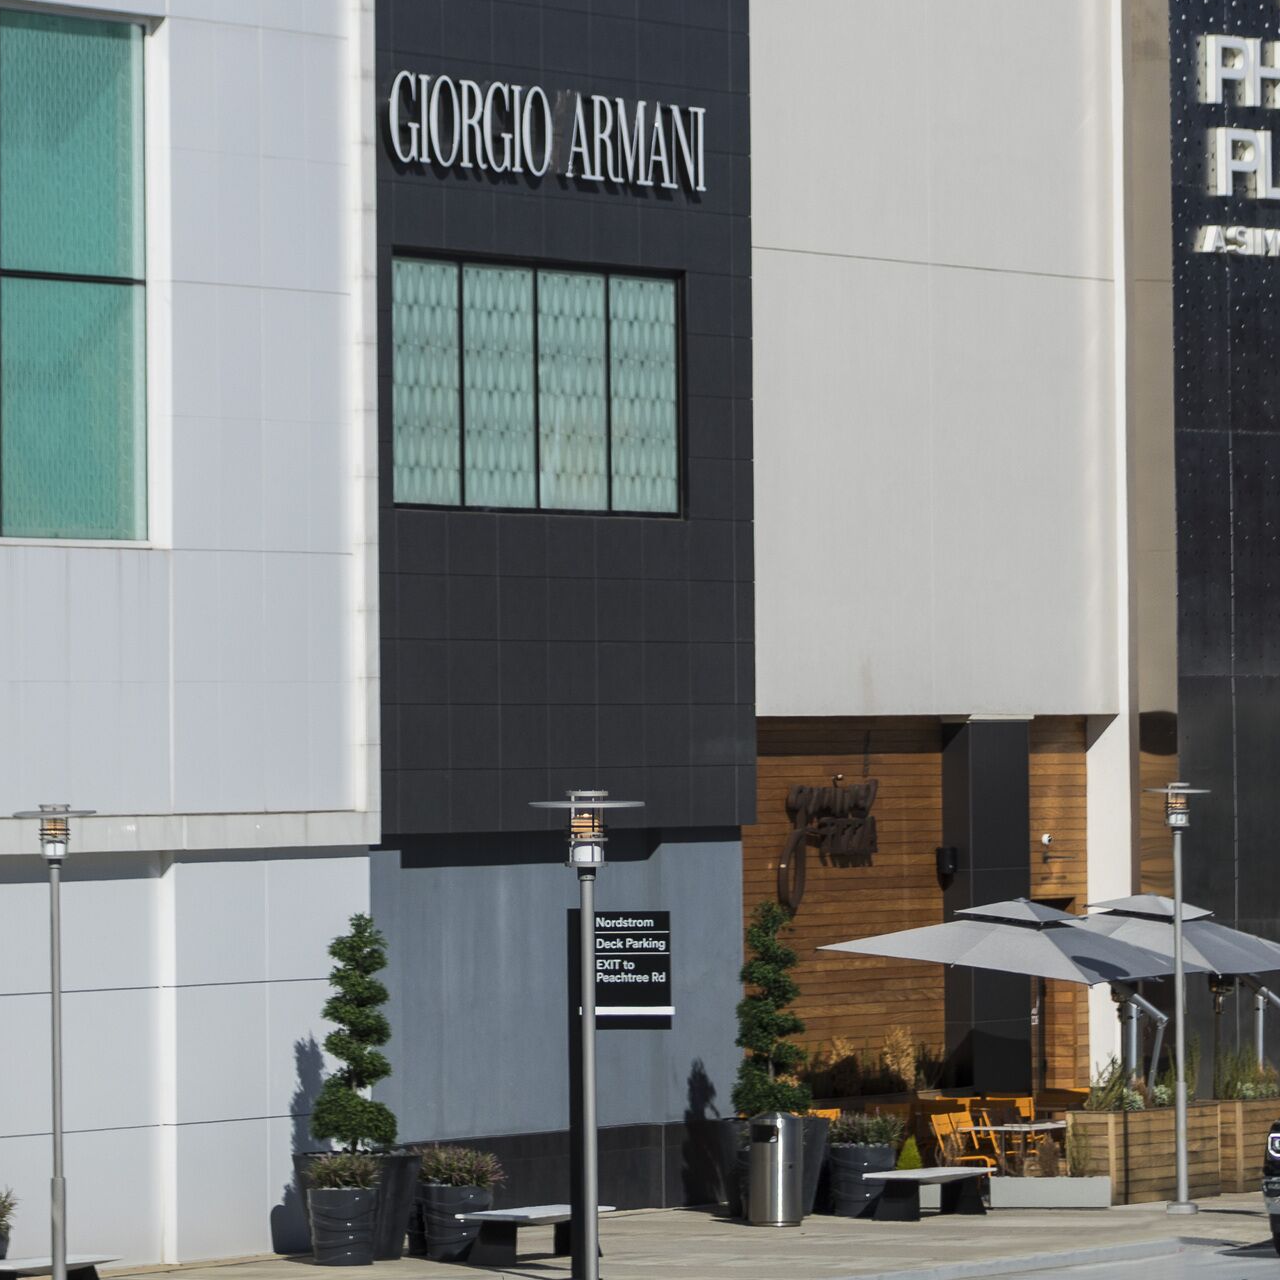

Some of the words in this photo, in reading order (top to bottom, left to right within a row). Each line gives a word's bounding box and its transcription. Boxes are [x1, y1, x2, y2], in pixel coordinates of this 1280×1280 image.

[389, 70, 553, 177] GIORGIO
[566, 92, 706, 191] ARMANI
[1202, 225, 1228, 253] A
[595, 917, 654, 928] Nordstrom
[596, 938, 624, 949] Deck
[625, 937, 666, 951] Parking
[596, 959, 621, 970] EXIT
[623, 960, 635, 970] to
[596, 972, 649, 983] Peachtree
[651, 971, 666, 982] Rd
